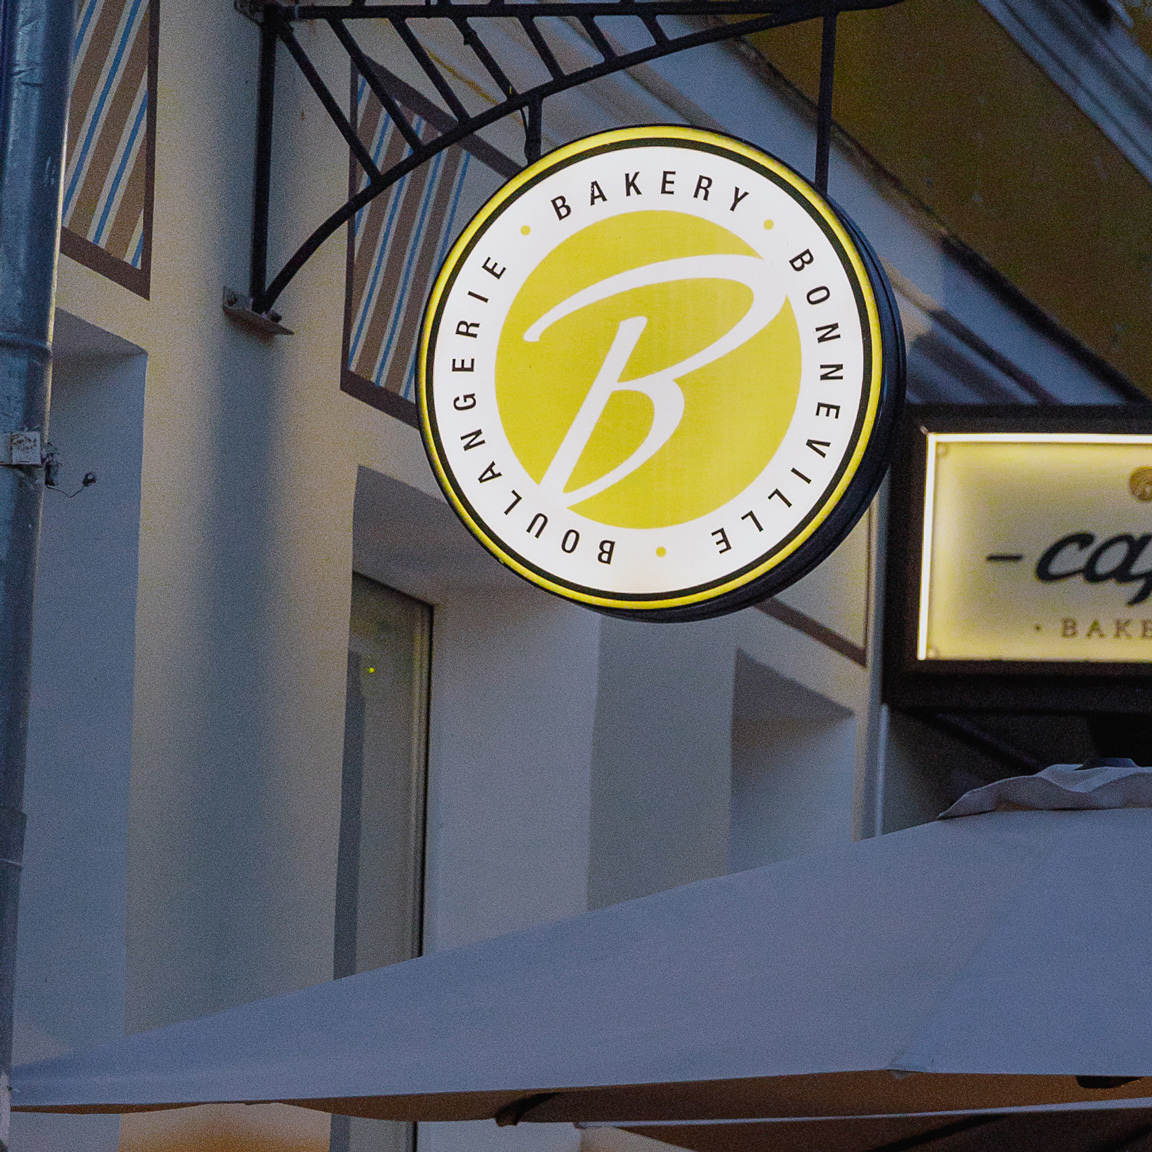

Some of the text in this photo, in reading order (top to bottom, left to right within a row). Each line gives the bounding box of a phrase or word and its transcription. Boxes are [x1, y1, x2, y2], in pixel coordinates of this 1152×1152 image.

[550, 170, 750, 221] BAKERY
[452, 256, 616, 565] BOULANGERIE
[711, 248, 844, 555] BONNEVILLE
